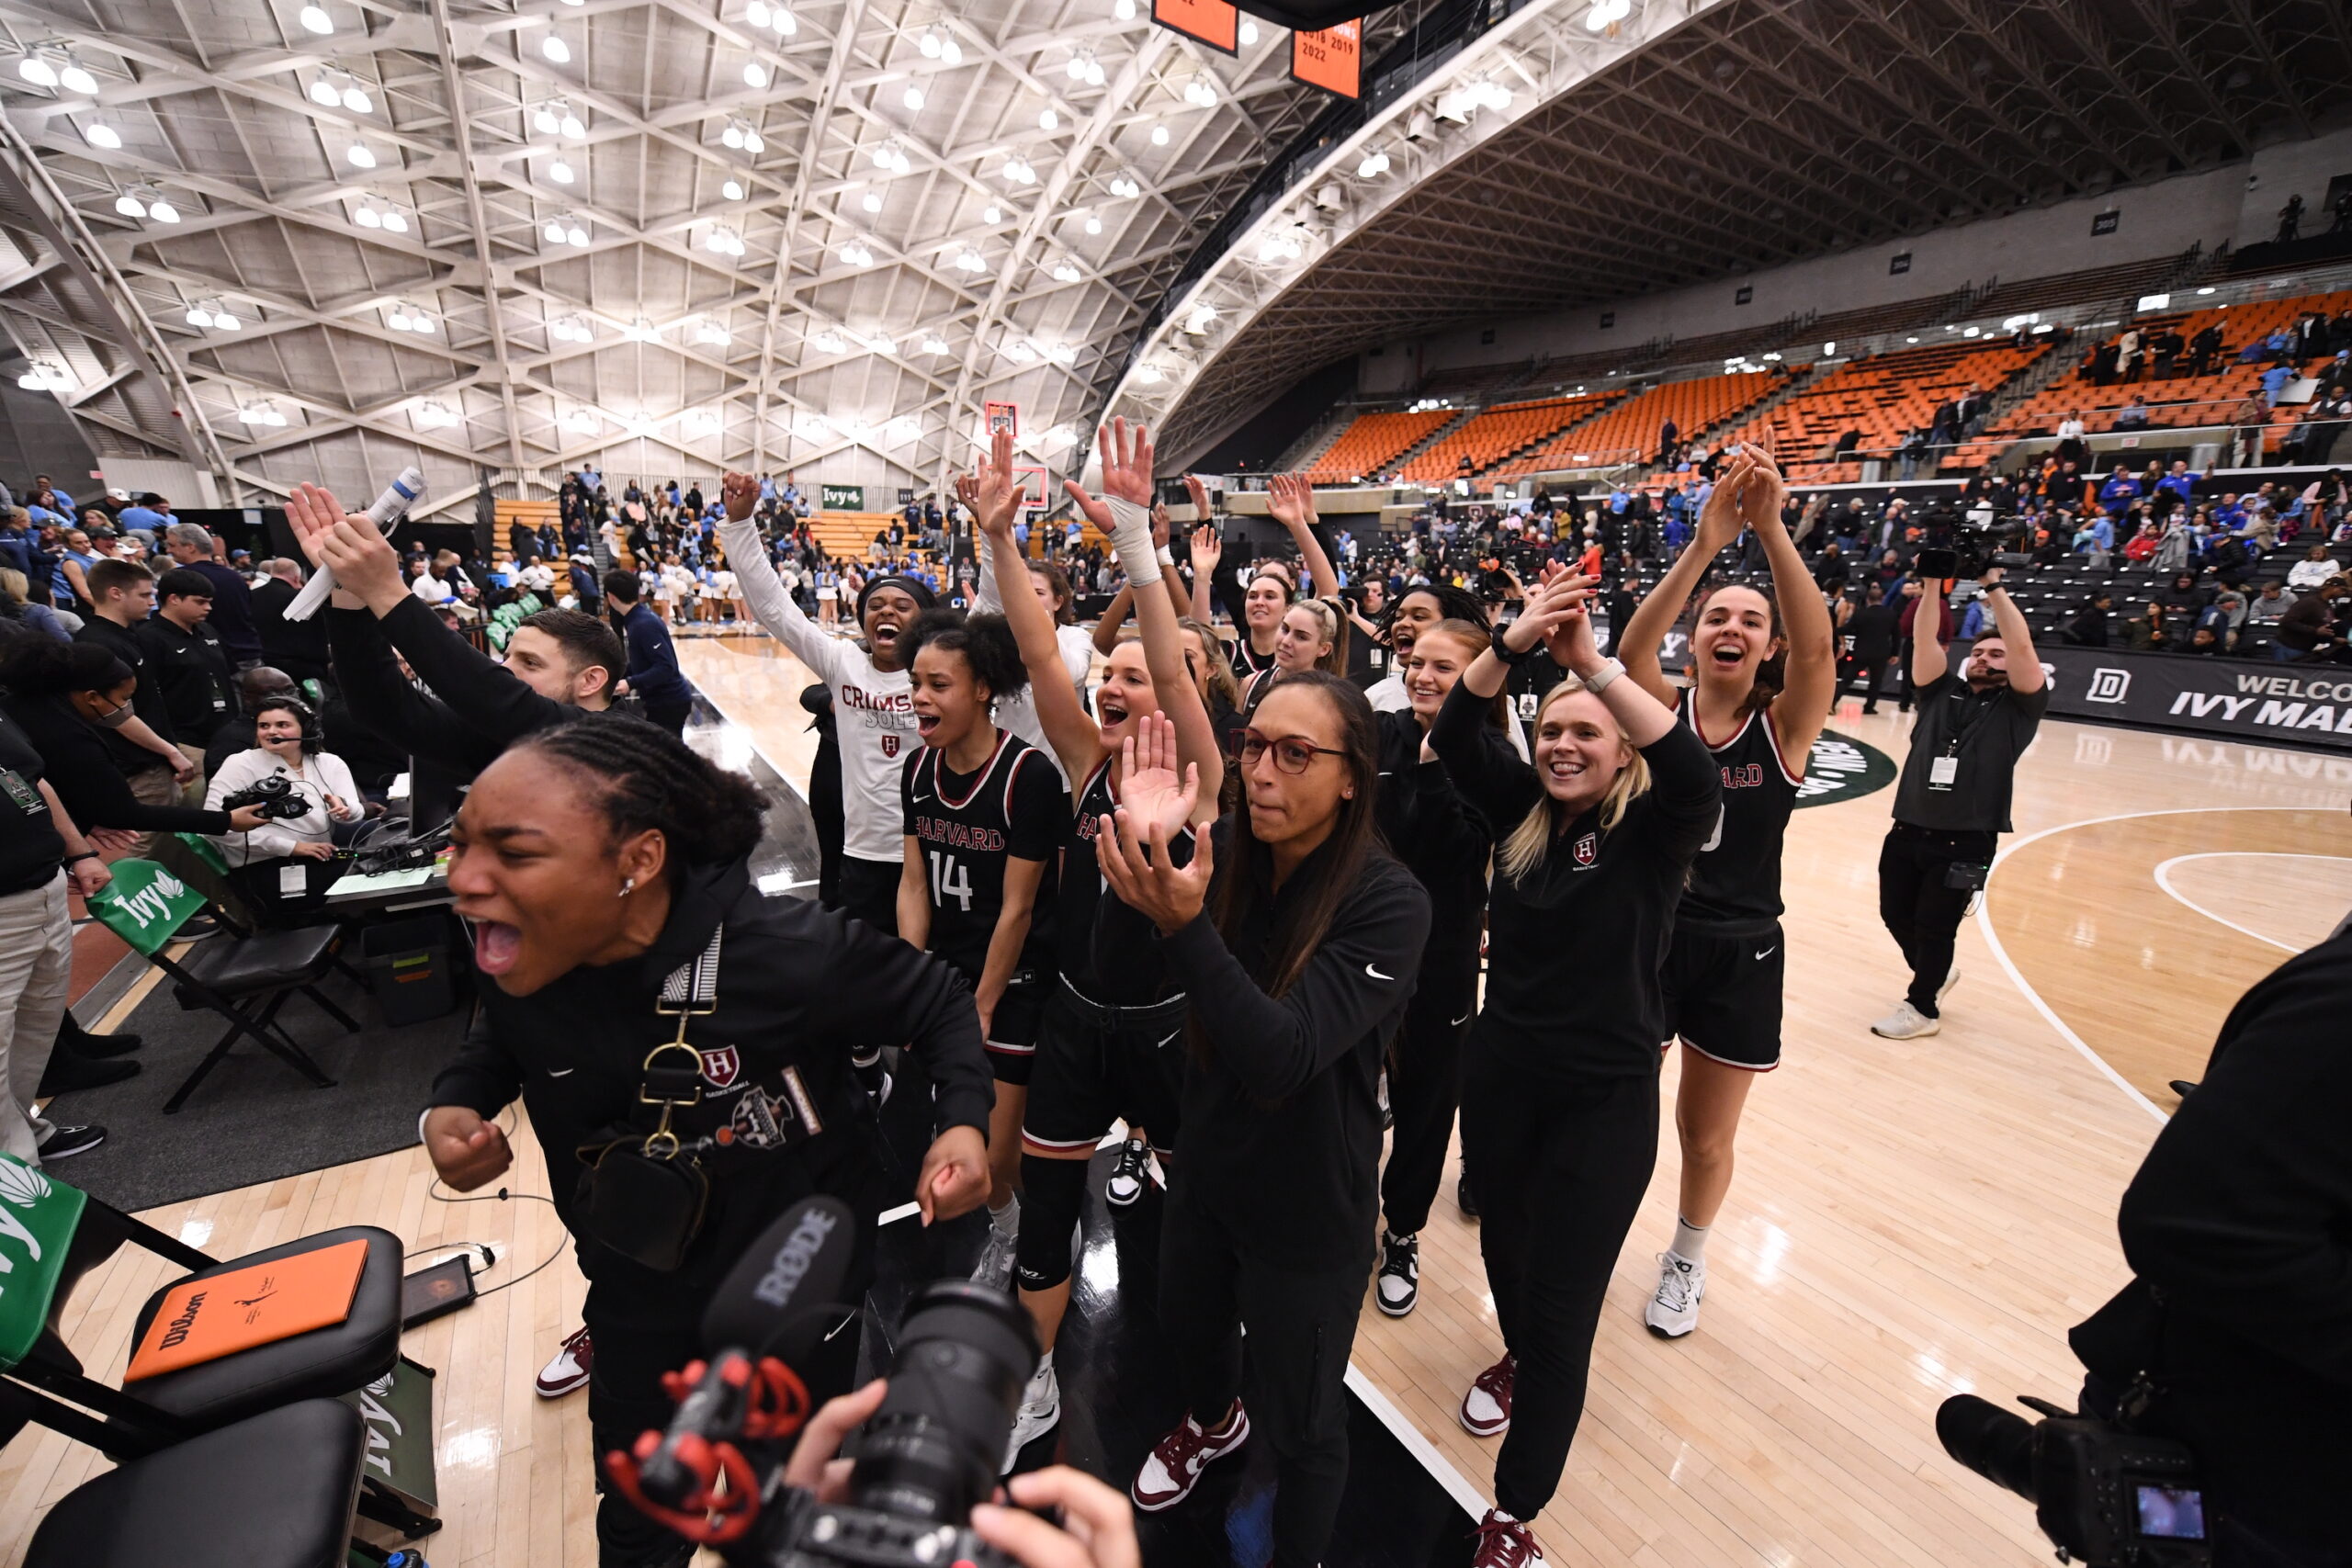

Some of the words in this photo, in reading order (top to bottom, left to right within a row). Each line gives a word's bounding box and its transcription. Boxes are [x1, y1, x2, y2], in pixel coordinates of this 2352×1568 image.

[1303, 42, 1326, 62] 2022
[1331, 37, 1353, 55] 2019
[823, 488, 847, 505] Ivy
[842, 684, 912, 712] CRIMS
[2086, 667, 2132, 704] D
[2237, 674, 2352, 703] WELCO
[2169, 691, 2257, 721] IVY
[885, 737, 897, 751] H
[1578, 841, 1592, 858] H
[930, 851, 973, 911] 14
[113, 885, 172, 929] Ivy
[705, 1052, 732, 1077] H
[159, 1291, 208, 1351] Wilson
